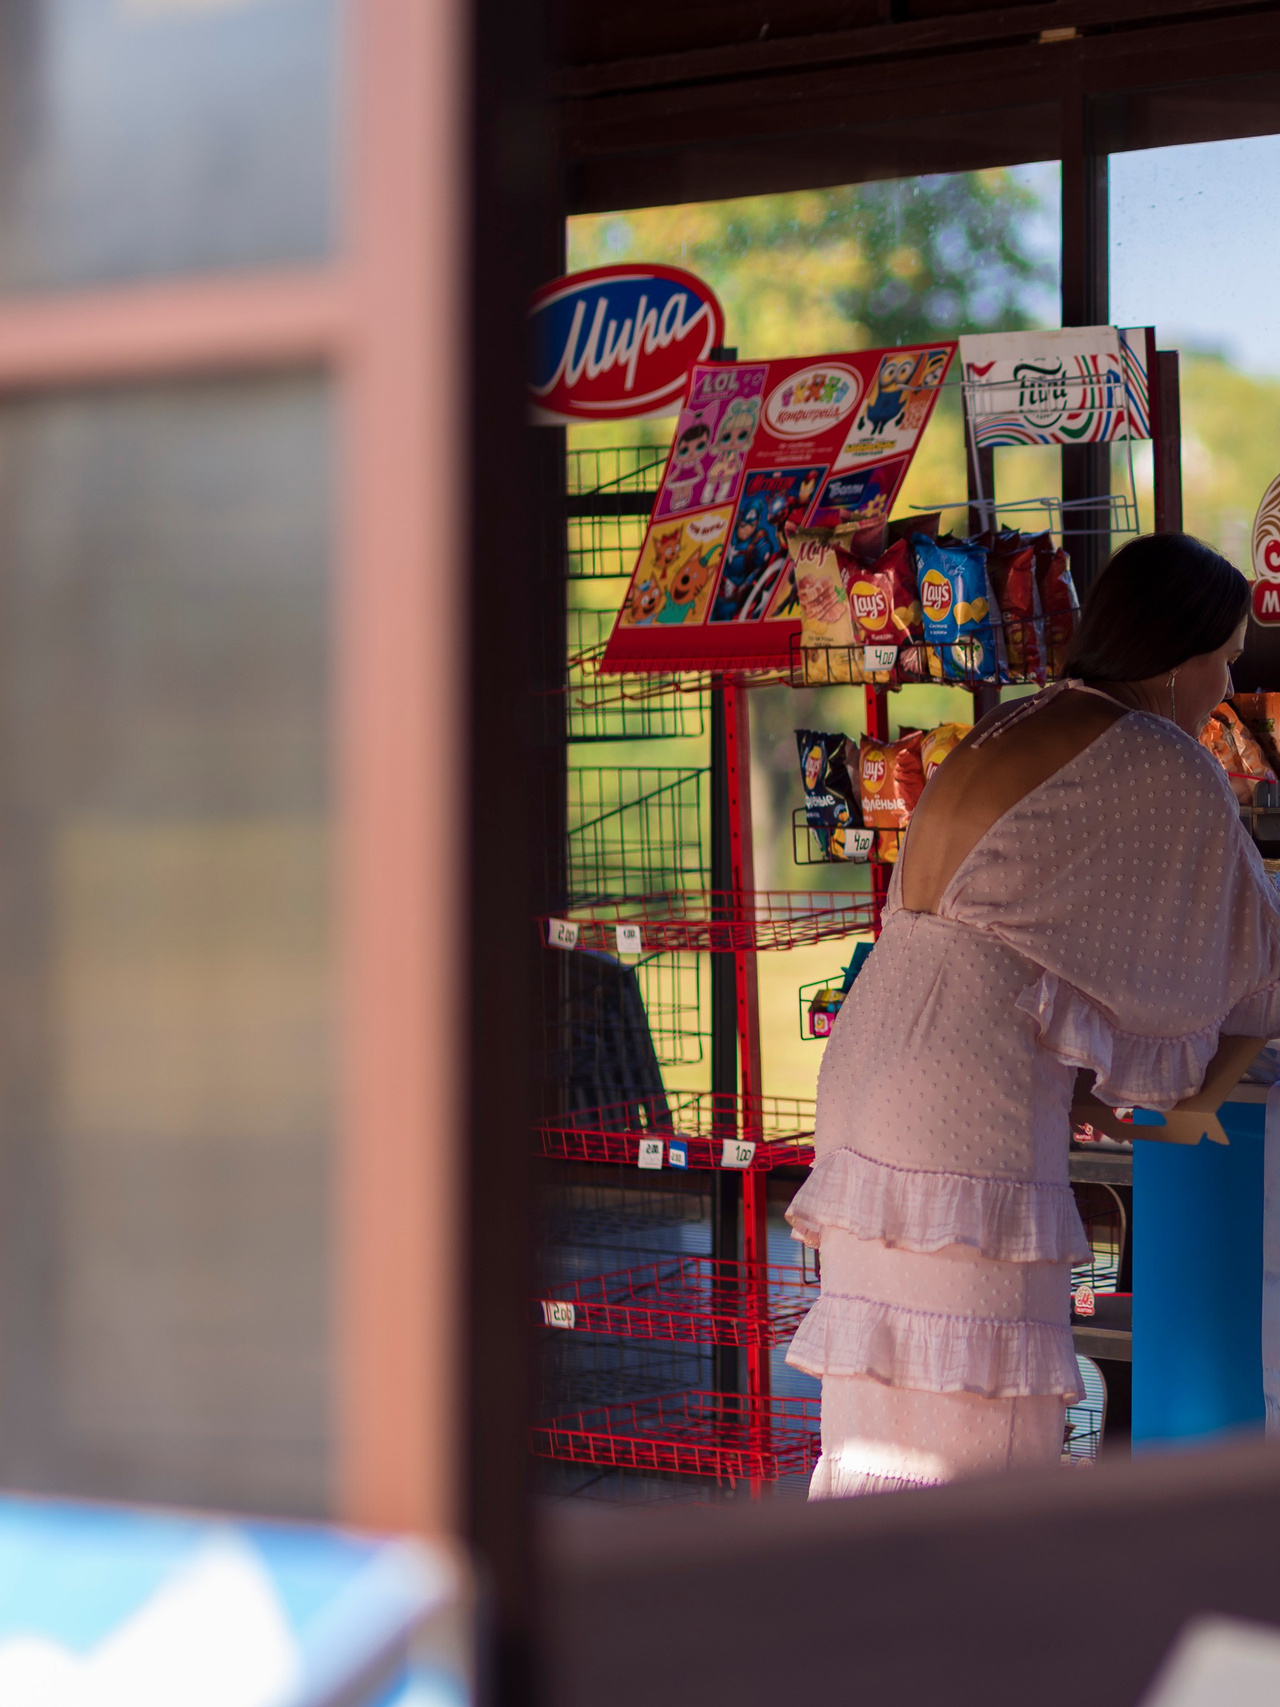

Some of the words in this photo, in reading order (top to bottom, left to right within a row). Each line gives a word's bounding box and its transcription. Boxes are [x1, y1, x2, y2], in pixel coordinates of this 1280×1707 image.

[534, 292, 707, 396] Мира
[853, 592, 885, 619] Lay's
[923, 582, 949, 610] Lay's
[863, 760, 884, 782] Lay's
